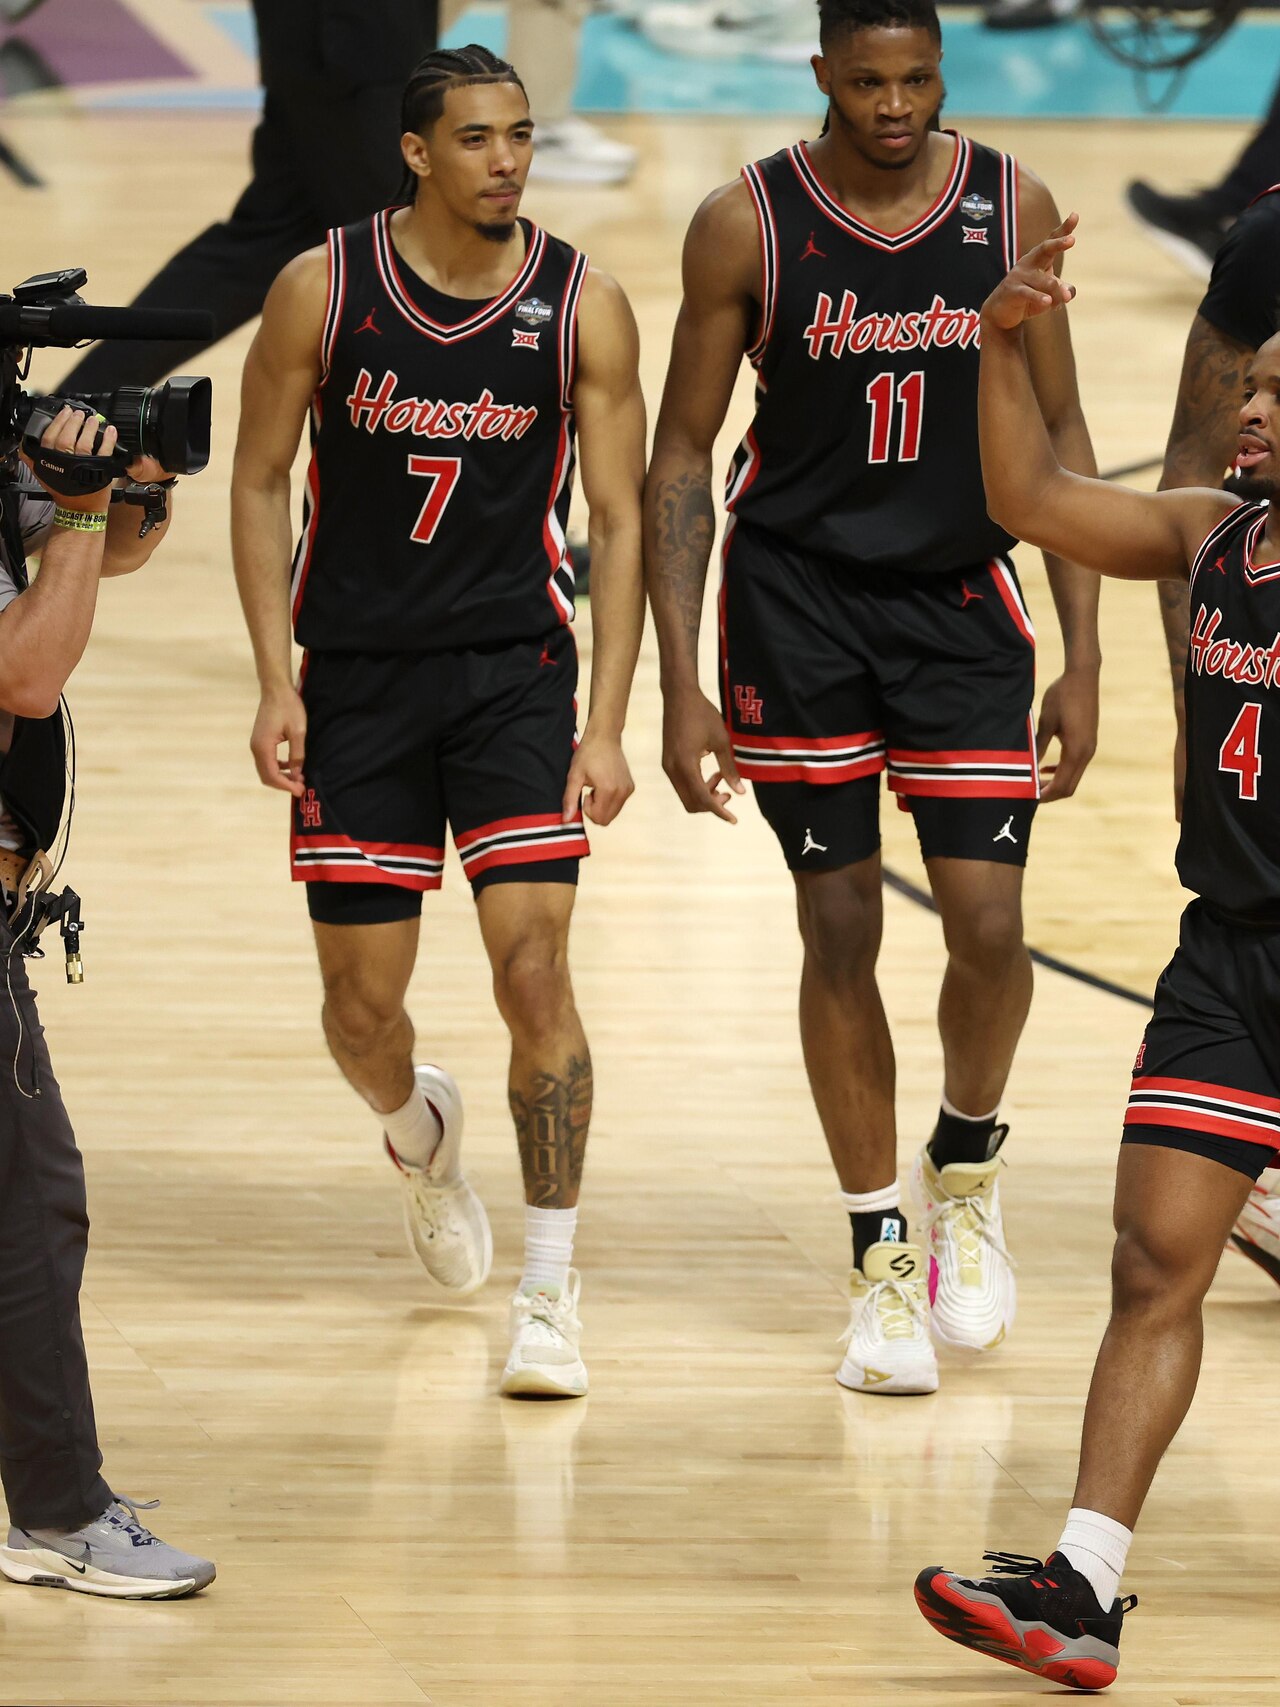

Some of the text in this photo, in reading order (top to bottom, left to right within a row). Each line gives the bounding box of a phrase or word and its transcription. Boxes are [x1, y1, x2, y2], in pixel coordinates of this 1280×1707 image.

[803, 289, 982, 361] Houston
[346, 367, 539, 442] Houston
[866, 370, 925, 464] 11
[41, 460, 65, 474] Canon
[407, 453, 463, 545] 7
[1218, 701, 1262, 801] 4
